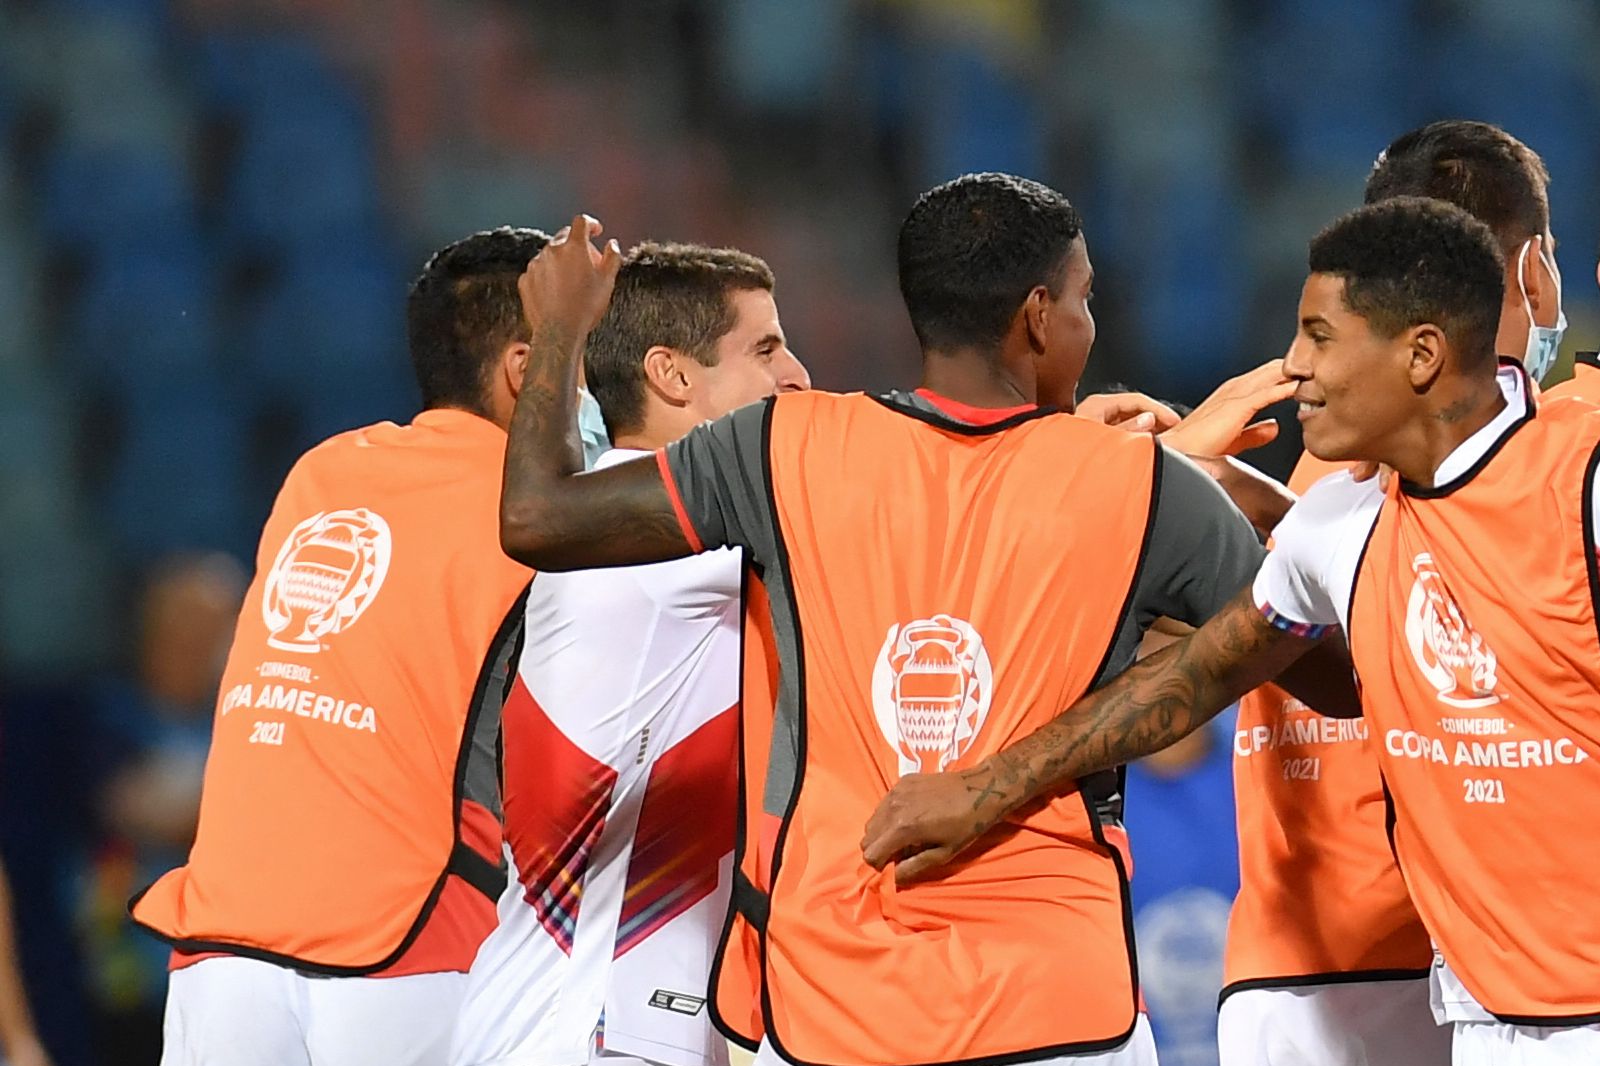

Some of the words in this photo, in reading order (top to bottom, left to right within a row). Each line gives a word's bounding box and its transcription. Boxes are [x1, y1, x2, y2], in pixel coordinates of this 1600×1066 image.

[254, 684, 377, 734] AMERICA
[248, 720, 286, 746] 2021
[1440, 717, 1508, 736] CONMEBOL
[1384, 728, 1449, 766] COPA
[1462, 778, 1506, 804] 2021
